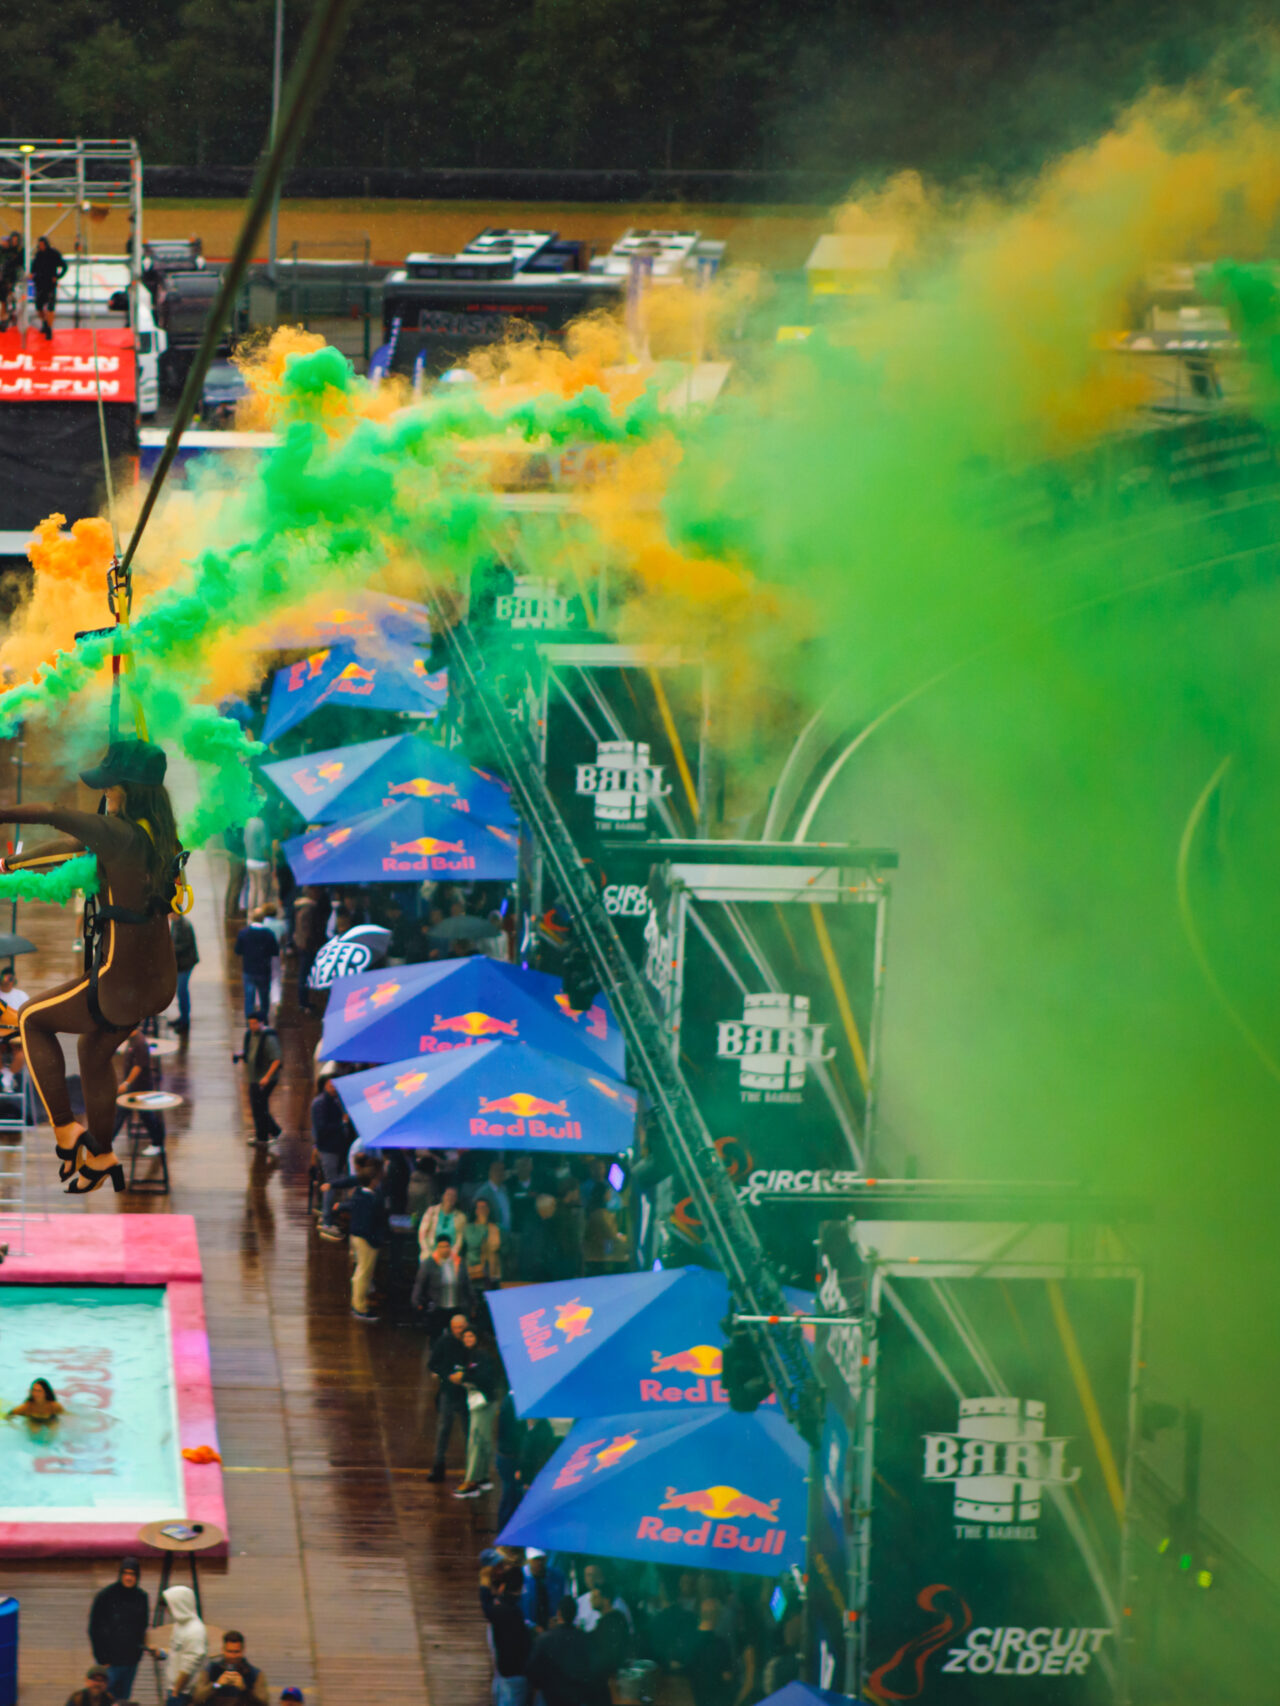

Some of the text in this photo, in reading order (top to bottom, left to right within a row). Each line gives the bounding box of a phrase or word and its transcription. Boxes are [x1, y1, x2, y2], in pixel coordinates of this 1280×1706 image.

[381, 856, 476, 871] Red Bull
[469, 1118, 582, 1140] Red Bull
[639, 1379, 708, 1403] Red
[636, 1516, 787, 1555] Red Bull
[955, 1525, 1038, 1540] THE BARREL
[966, 1626, 1112, 1652] CIRCUIT
[941, 1649, 1091, 1676] ZOLDER
